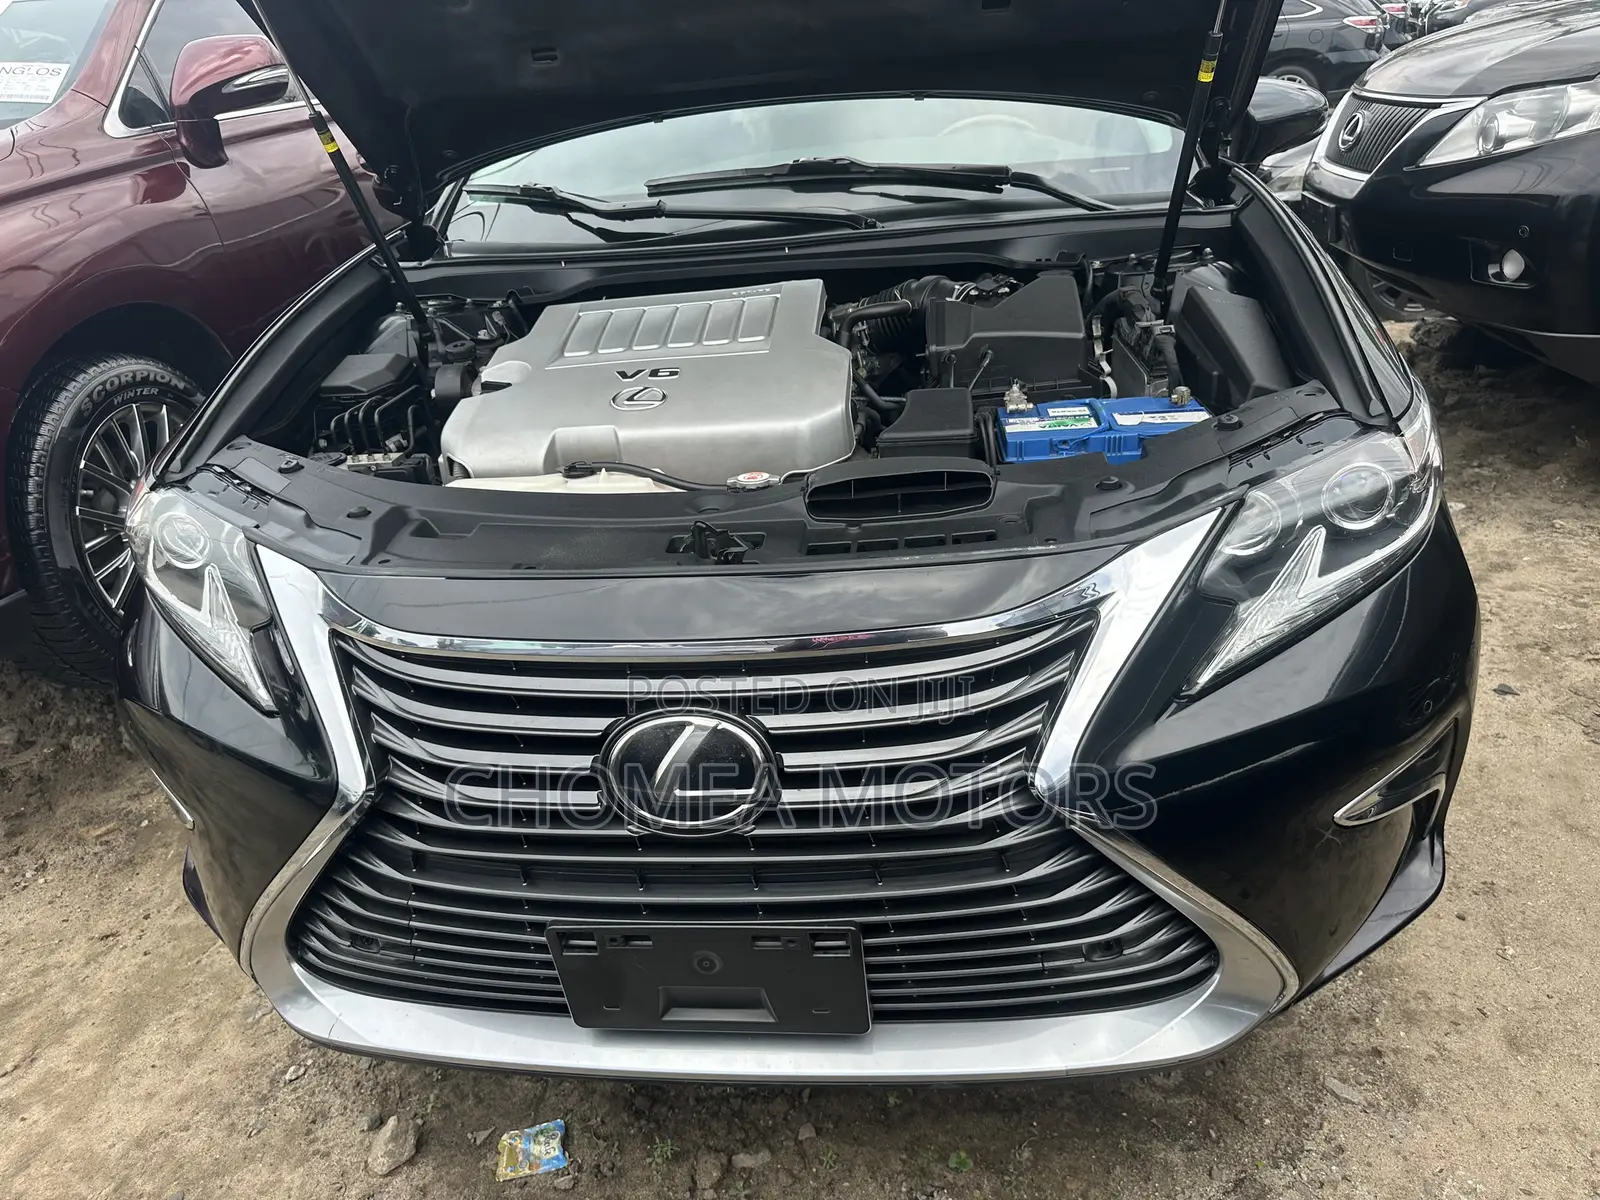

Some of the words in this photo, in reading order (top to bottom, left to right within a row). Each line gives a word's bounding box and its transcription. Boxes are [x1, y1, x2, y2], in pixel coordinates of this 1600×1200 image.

[614, 366, 680, 382] V6
[80, 370, 186, 417] SCORPION
[113, 387, 159, 405] WINTER
